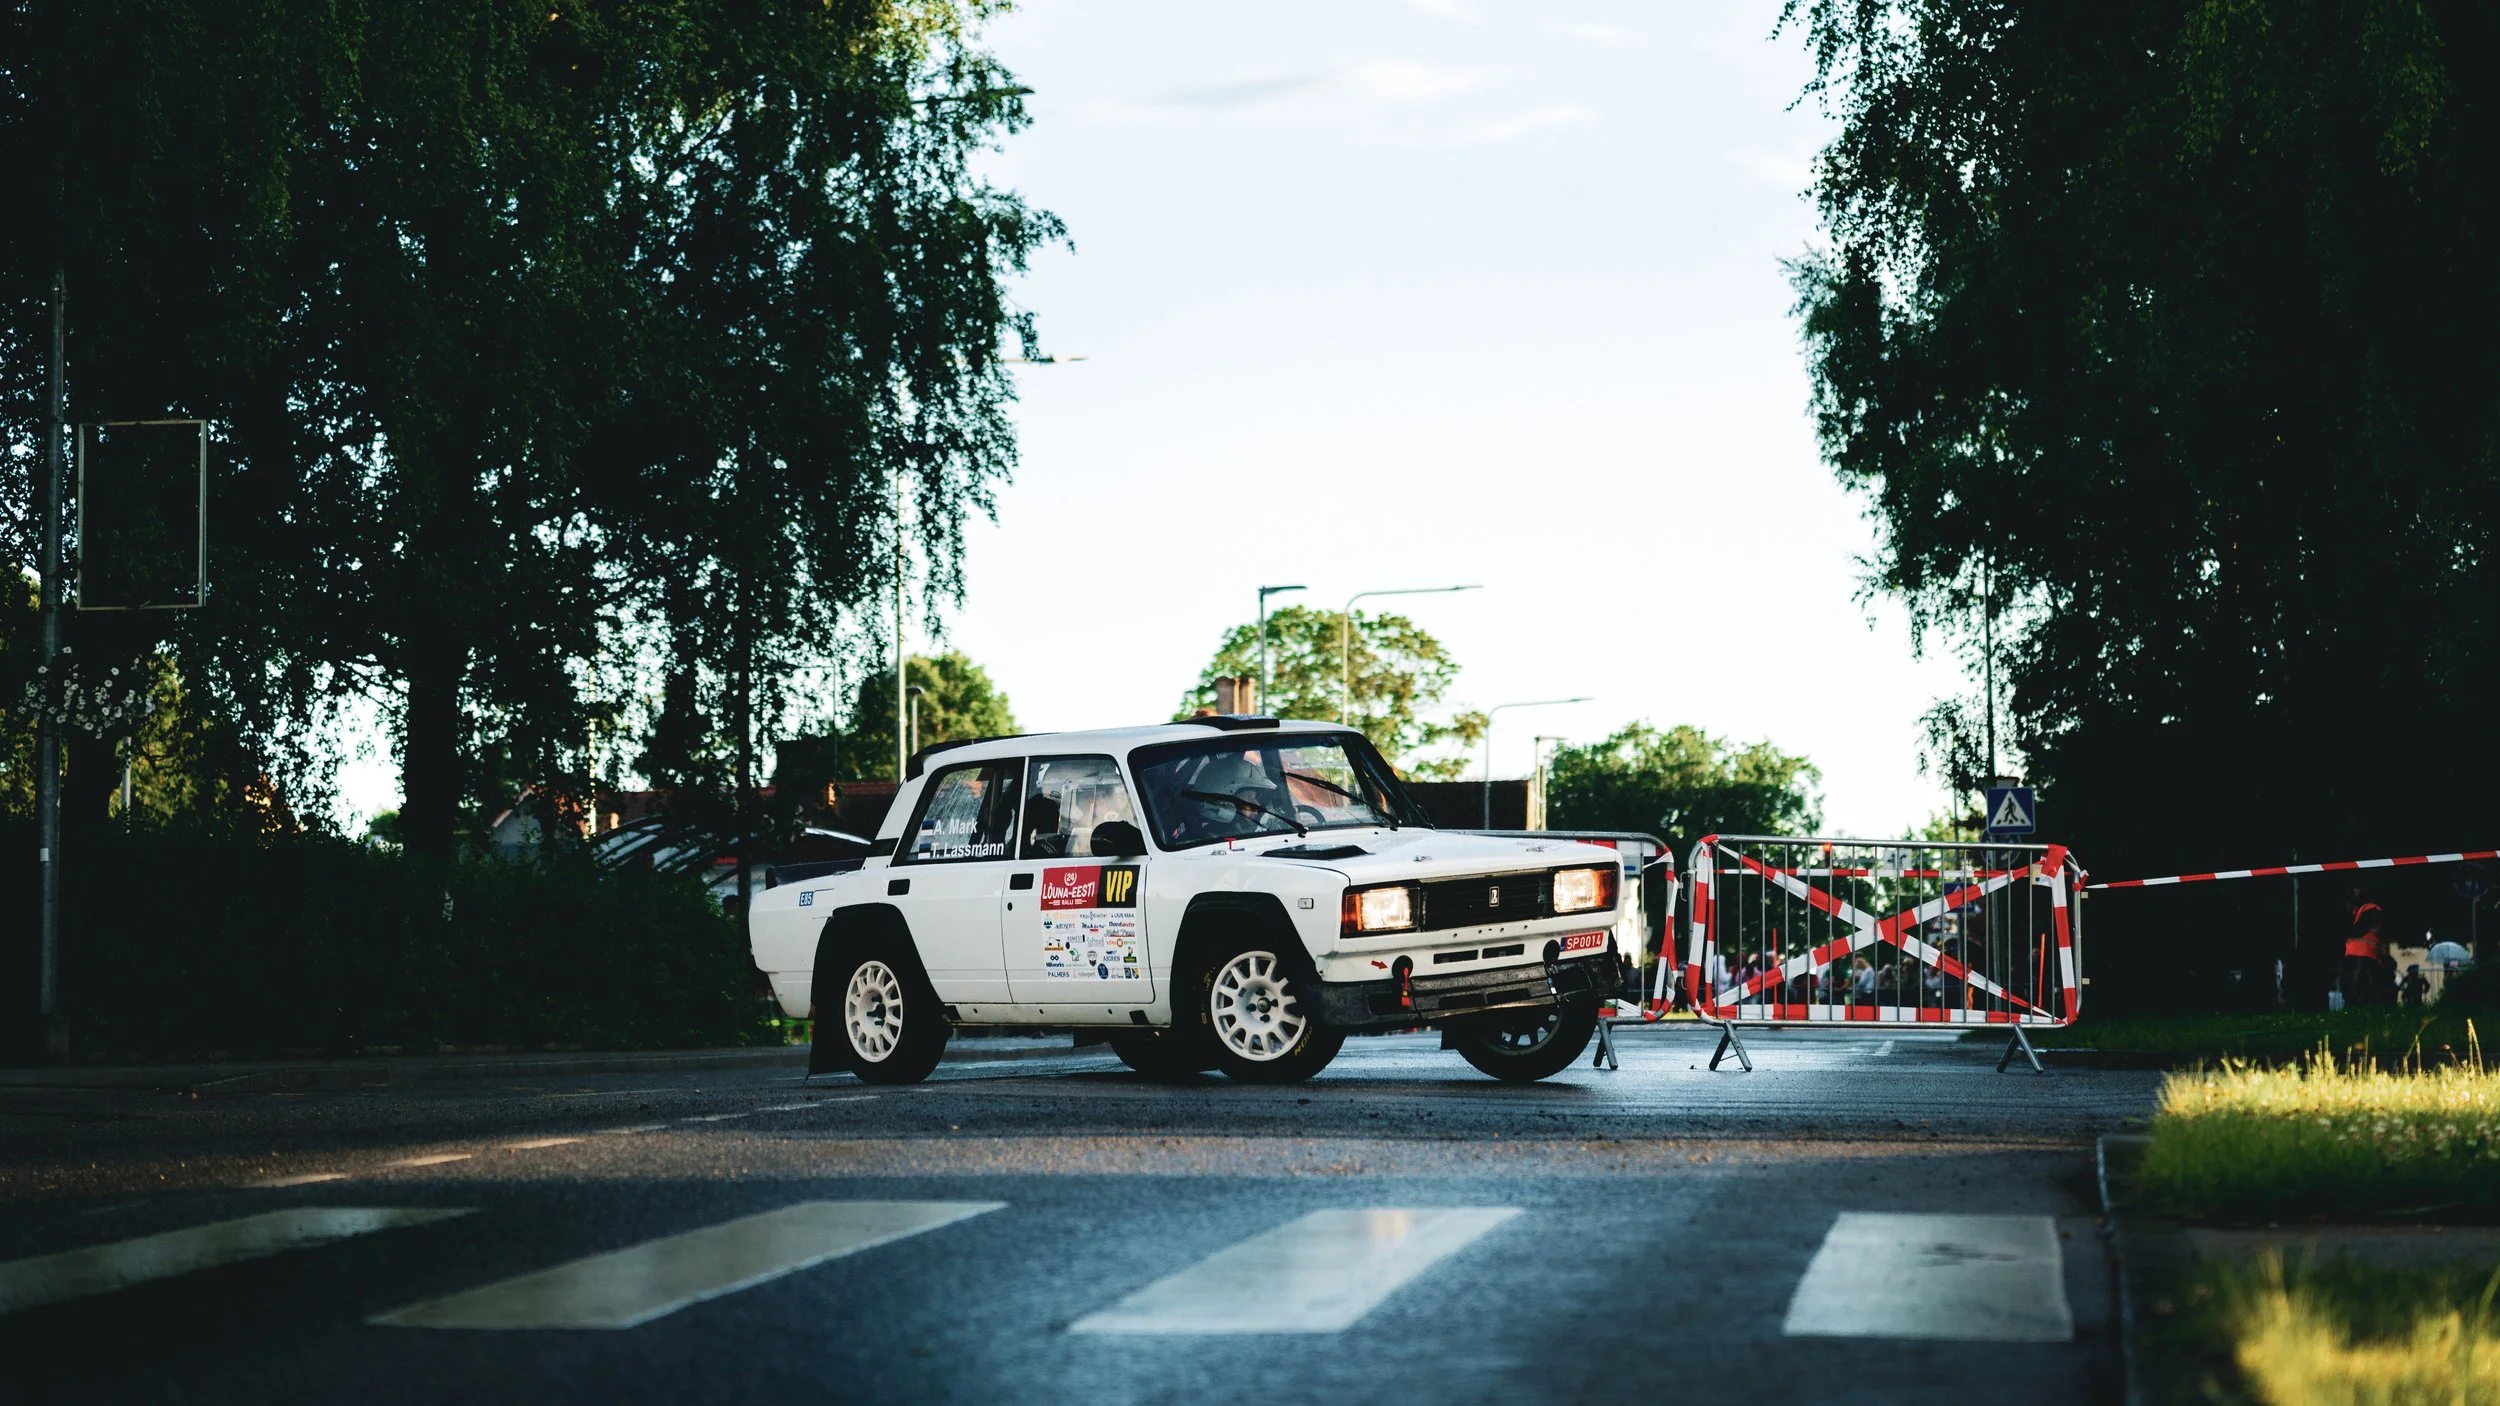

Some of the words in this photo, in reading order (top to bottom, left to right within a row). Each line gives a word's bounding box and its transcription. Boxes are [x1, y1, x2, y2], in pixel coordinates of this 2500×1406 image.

[933, 819, 945, 836] A.
[949, 817, 978, 835] Mark
[931, 842, 940, 859] T.
[943, 842, 1004, 858] Lassmann
[1106, 870, 1133, 903] VIP
[800, 892, 813, 906] E85
[1566, 934, 1601, 950] SP0014
